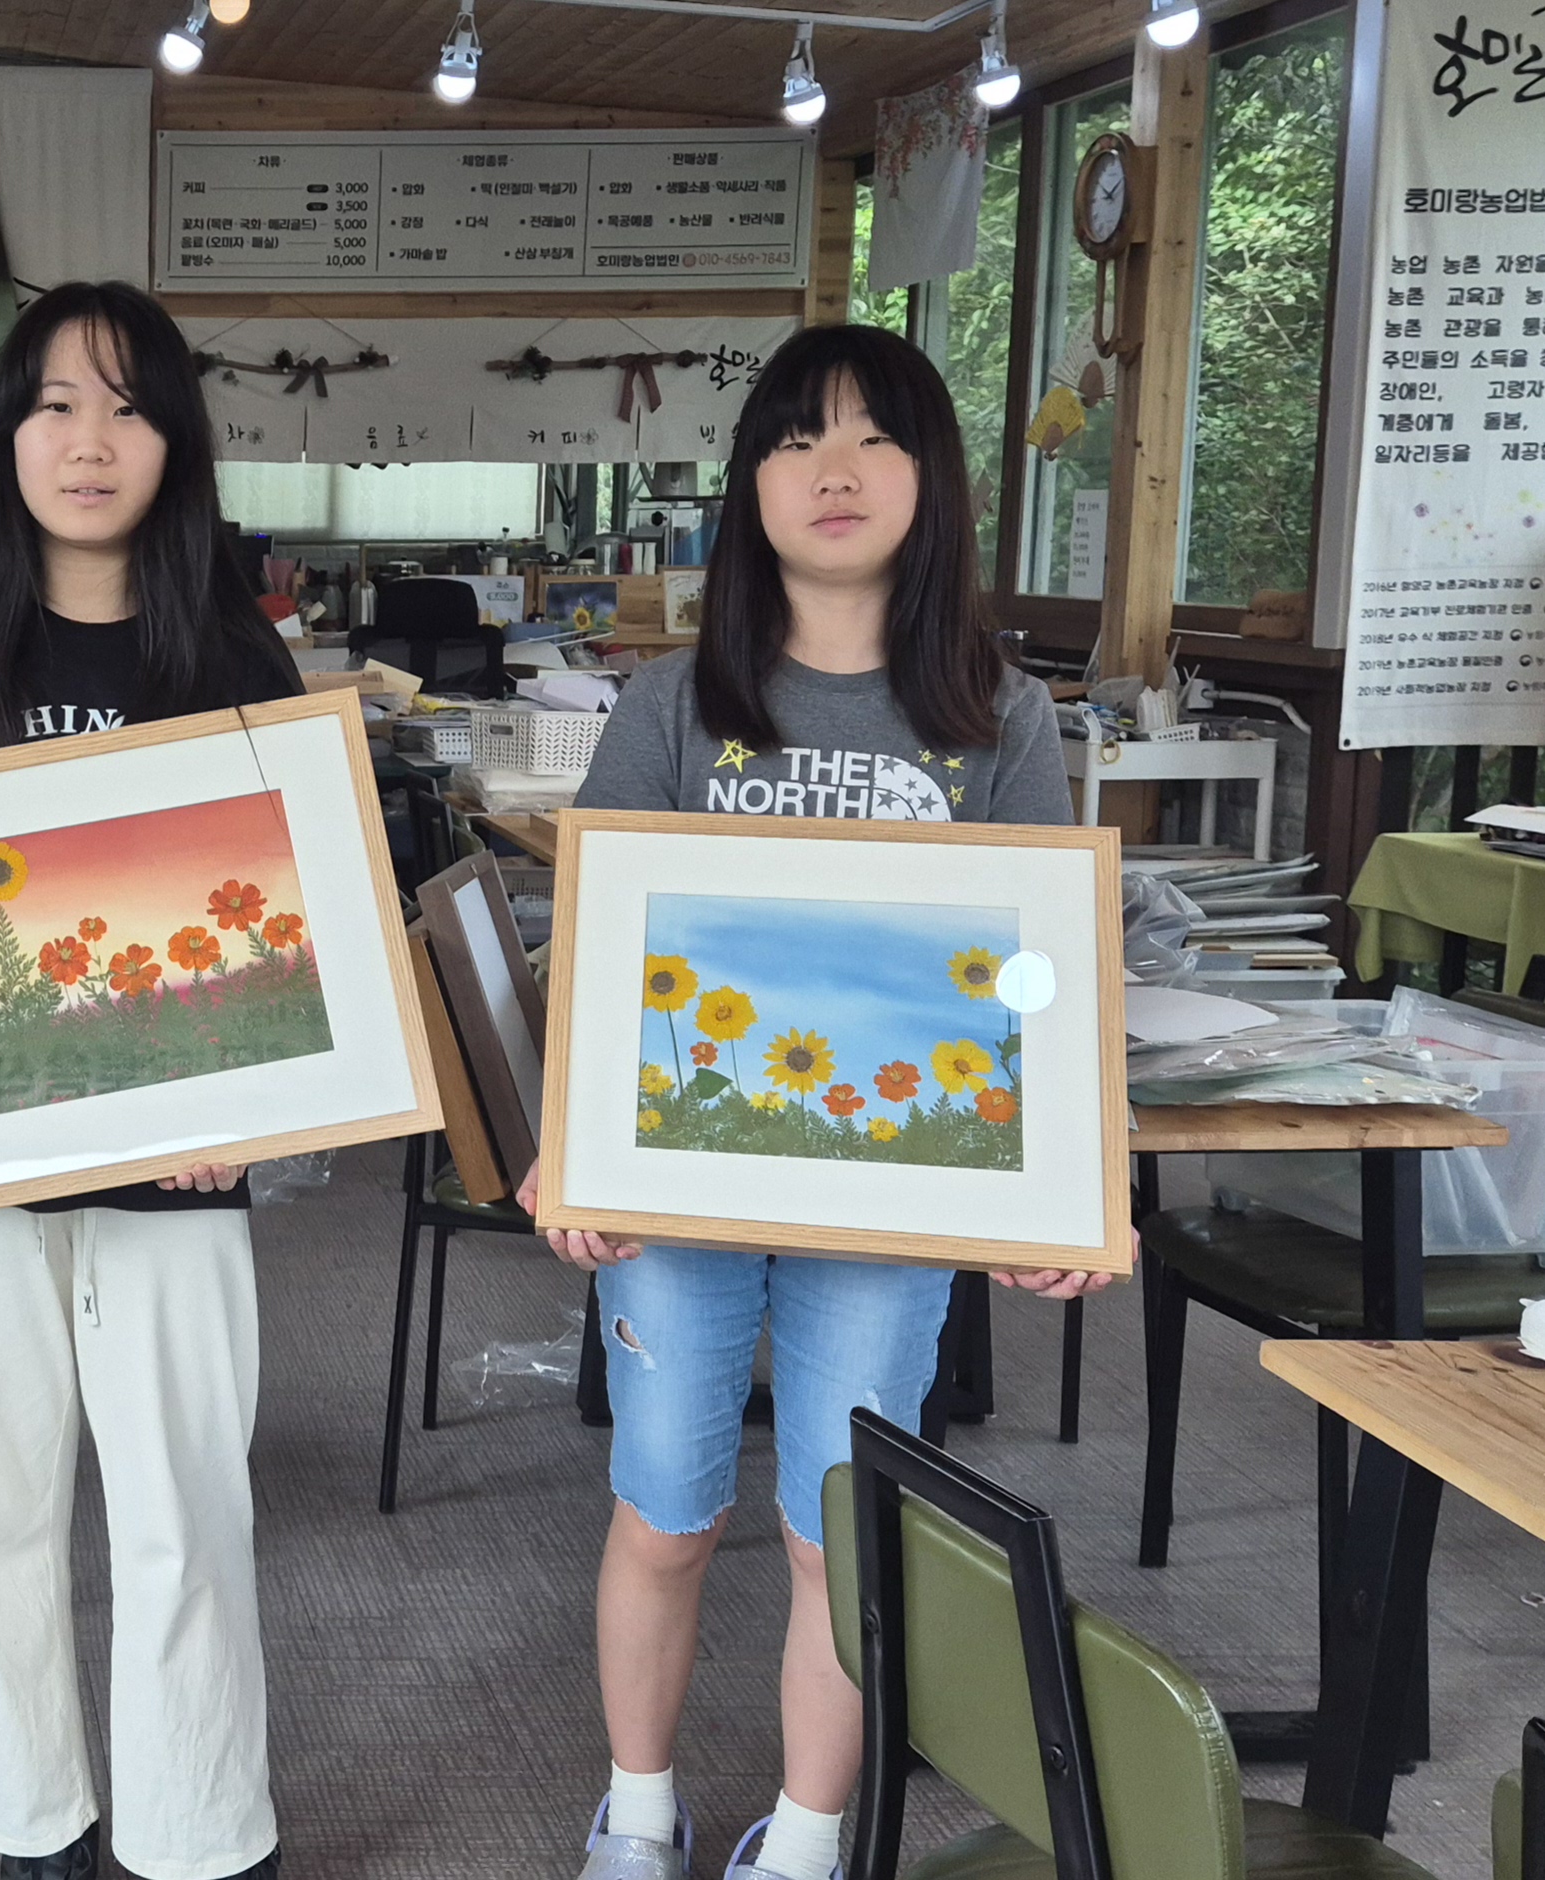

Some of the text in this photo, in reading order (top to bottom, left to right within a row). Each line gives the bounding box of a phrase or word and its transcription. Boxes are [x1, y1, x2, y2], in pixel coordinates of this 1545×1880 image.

[258, 155, 281, 168] 차류
[462, 155, 508, 167] 체험종류
[673, 152, 718, 166] 판매상품
[182, 181, 206, 194] 커피
[335, 182, 369, 196] 3,000
[402, 183, 425, 196] 압화
[335, 200, 368, 214] 3,500
[334, 218, 367, 232] 5,000
[401, 217, 424, 229] 강정
[466, 216, 489, 228] 다식
[530, 215, 576, 228] 전래놀이
[679, 214, 713, 226] 농산물
[181, 236, 204, 249] 음료
[334, 237, 367, 250] 5,000
[181, 254, 366, 268] 팥빙수 10,000
[1391, 255, 1427, 274] 농업
[1443, 255, 1481, 274] 농촌
[1387, 287, 1424, 306] 농촌
[1447, 287, 1504, 306] 교육과
[1384, 319, 1421, 338] 농촌
[1444, 319, 1501, 337] 관광을
[1382, 351, 1459, 369] 주민들의
[1470, 349, 1528, 368] 소득을
[1380, 382, 1443, 402] 장애인,
[1378, 412, 1528, 432] 계층에게 돌봄,
[1375, 442, 1545, 464] 일자리등을 제공
[782, 747, 872, 787] THE
[707, 778, 869, 819] NORTH
